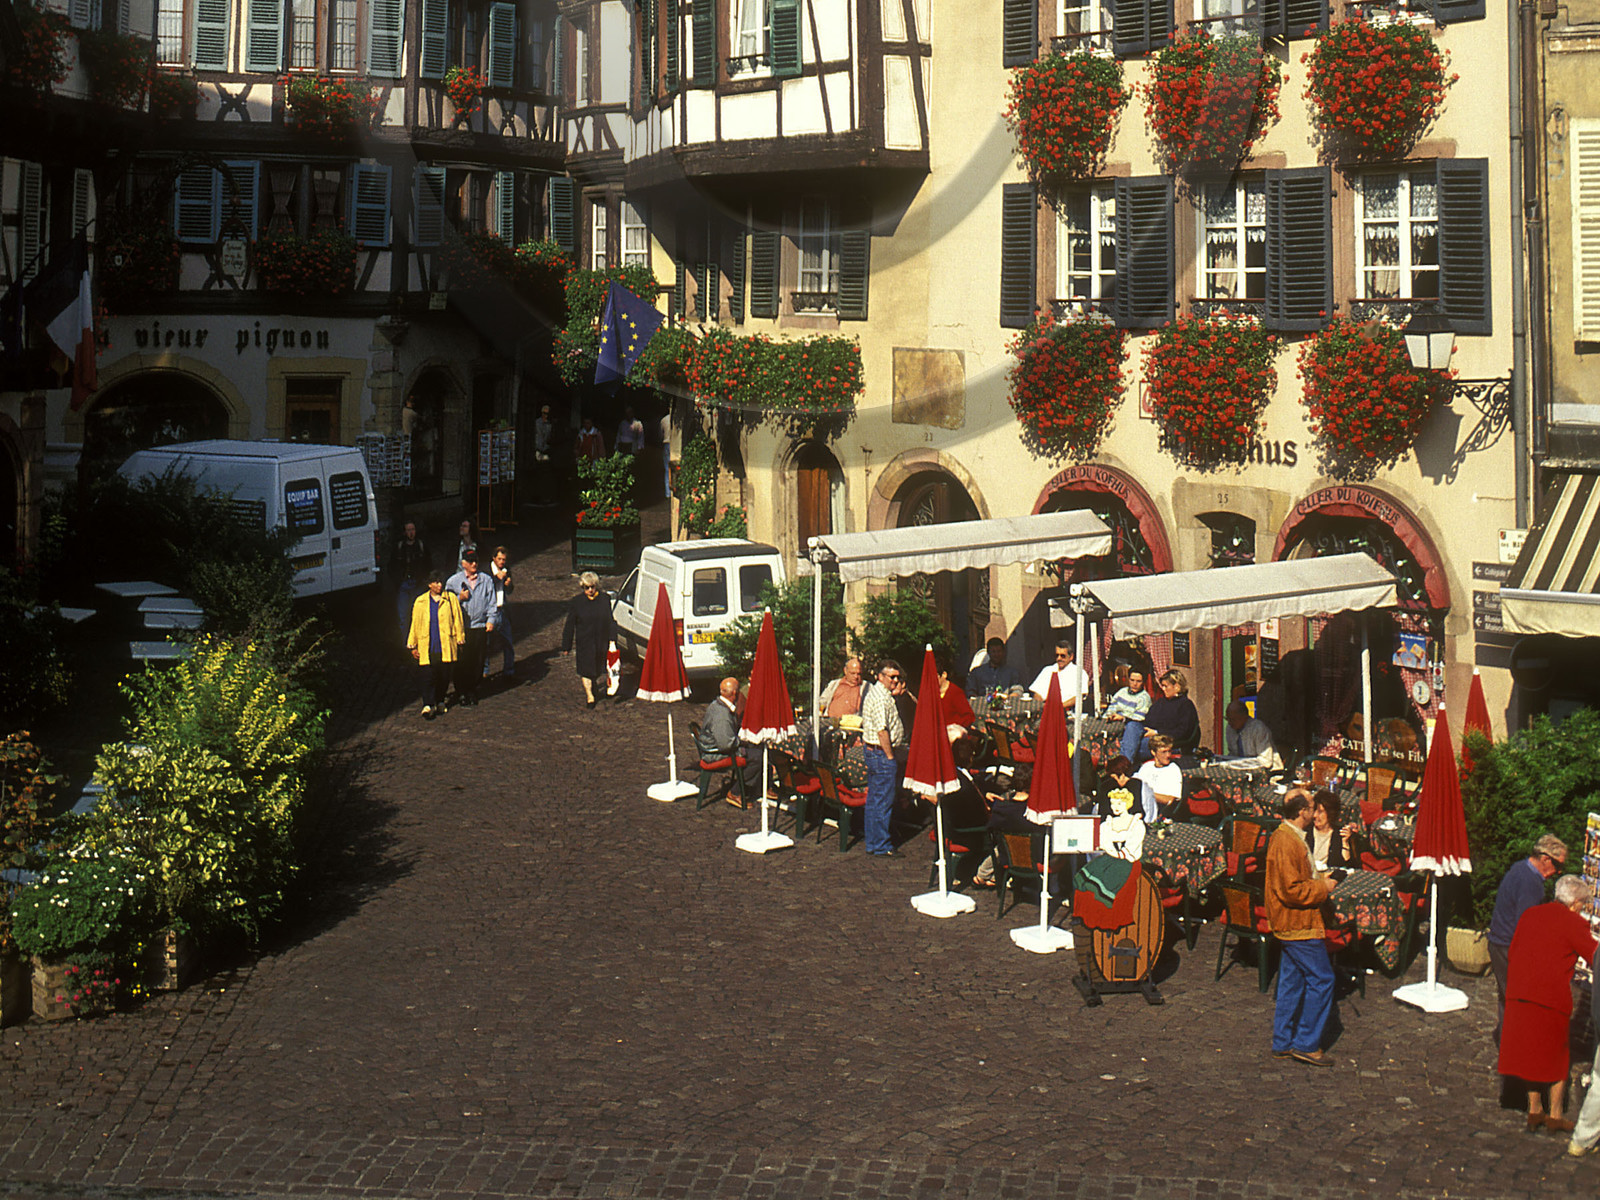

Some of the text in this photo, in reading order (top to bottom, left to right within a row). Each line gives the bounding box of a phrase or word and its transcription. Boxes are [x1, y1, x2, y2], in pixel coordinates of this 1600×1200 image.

[235, 321, 330, 355] pignon
[1080, 468, 1092, 478] DU
[1217, 493, 1228, 504] 25
[1337, 488, 1352, 501] DU
[1380, 748, 1389, 757] et
[1408, 750, 1425, 763] Fils
